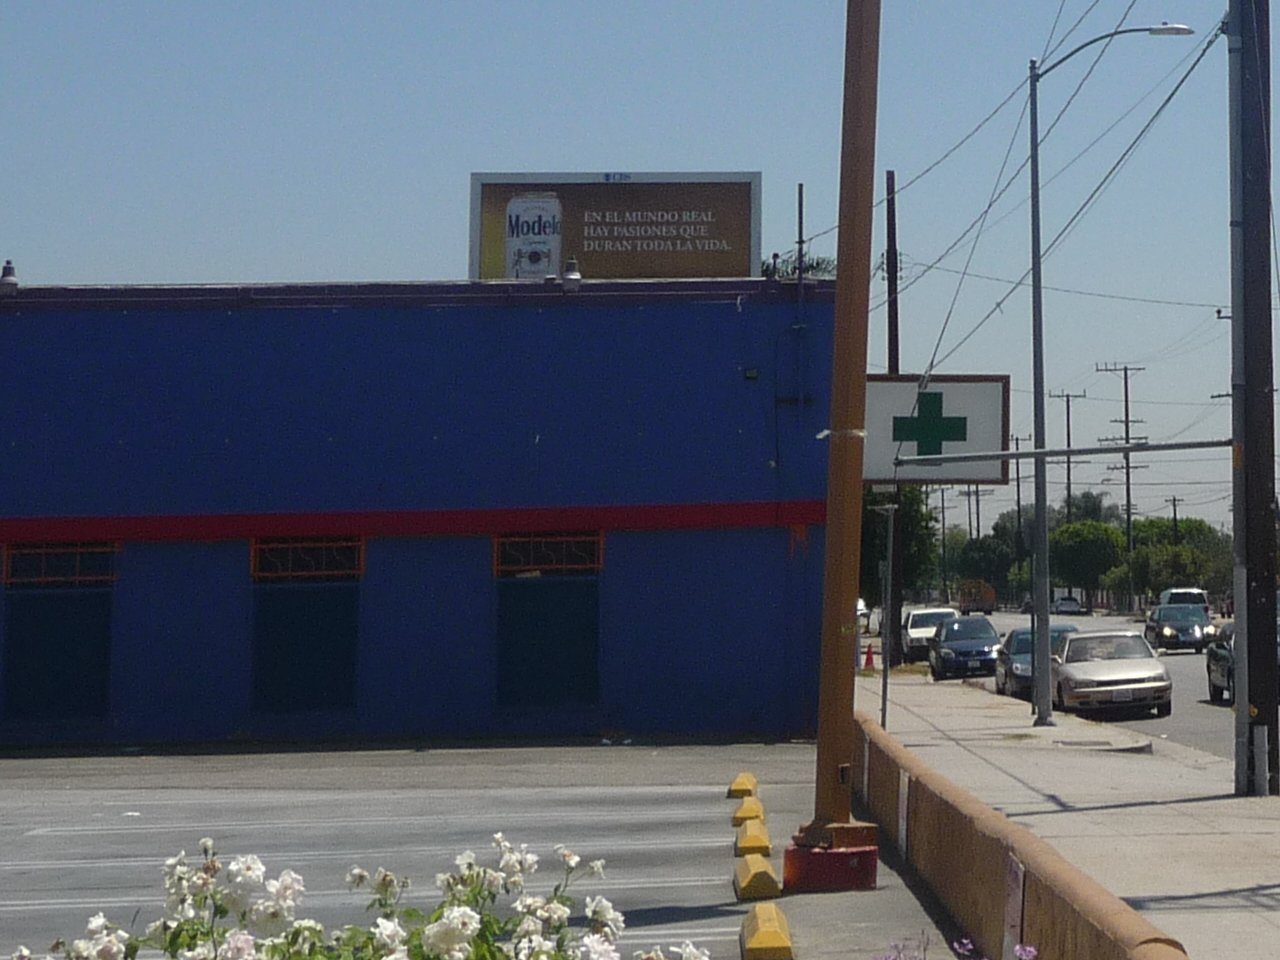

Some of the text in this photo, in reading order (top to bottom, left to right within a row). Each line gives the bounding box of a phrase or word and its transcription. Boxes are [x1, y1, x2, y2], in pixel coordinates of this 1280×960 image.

[612, 172, 632, 181] CBS
[584, 210, 715, 223] EN EL MUNDO REAL
[508, 214, 563, 239] Modelo
[584, 225, 709, 238] HAY PASIONES QUE
[584, 240, 732, 252] DURAN TODA LA VIDA.
